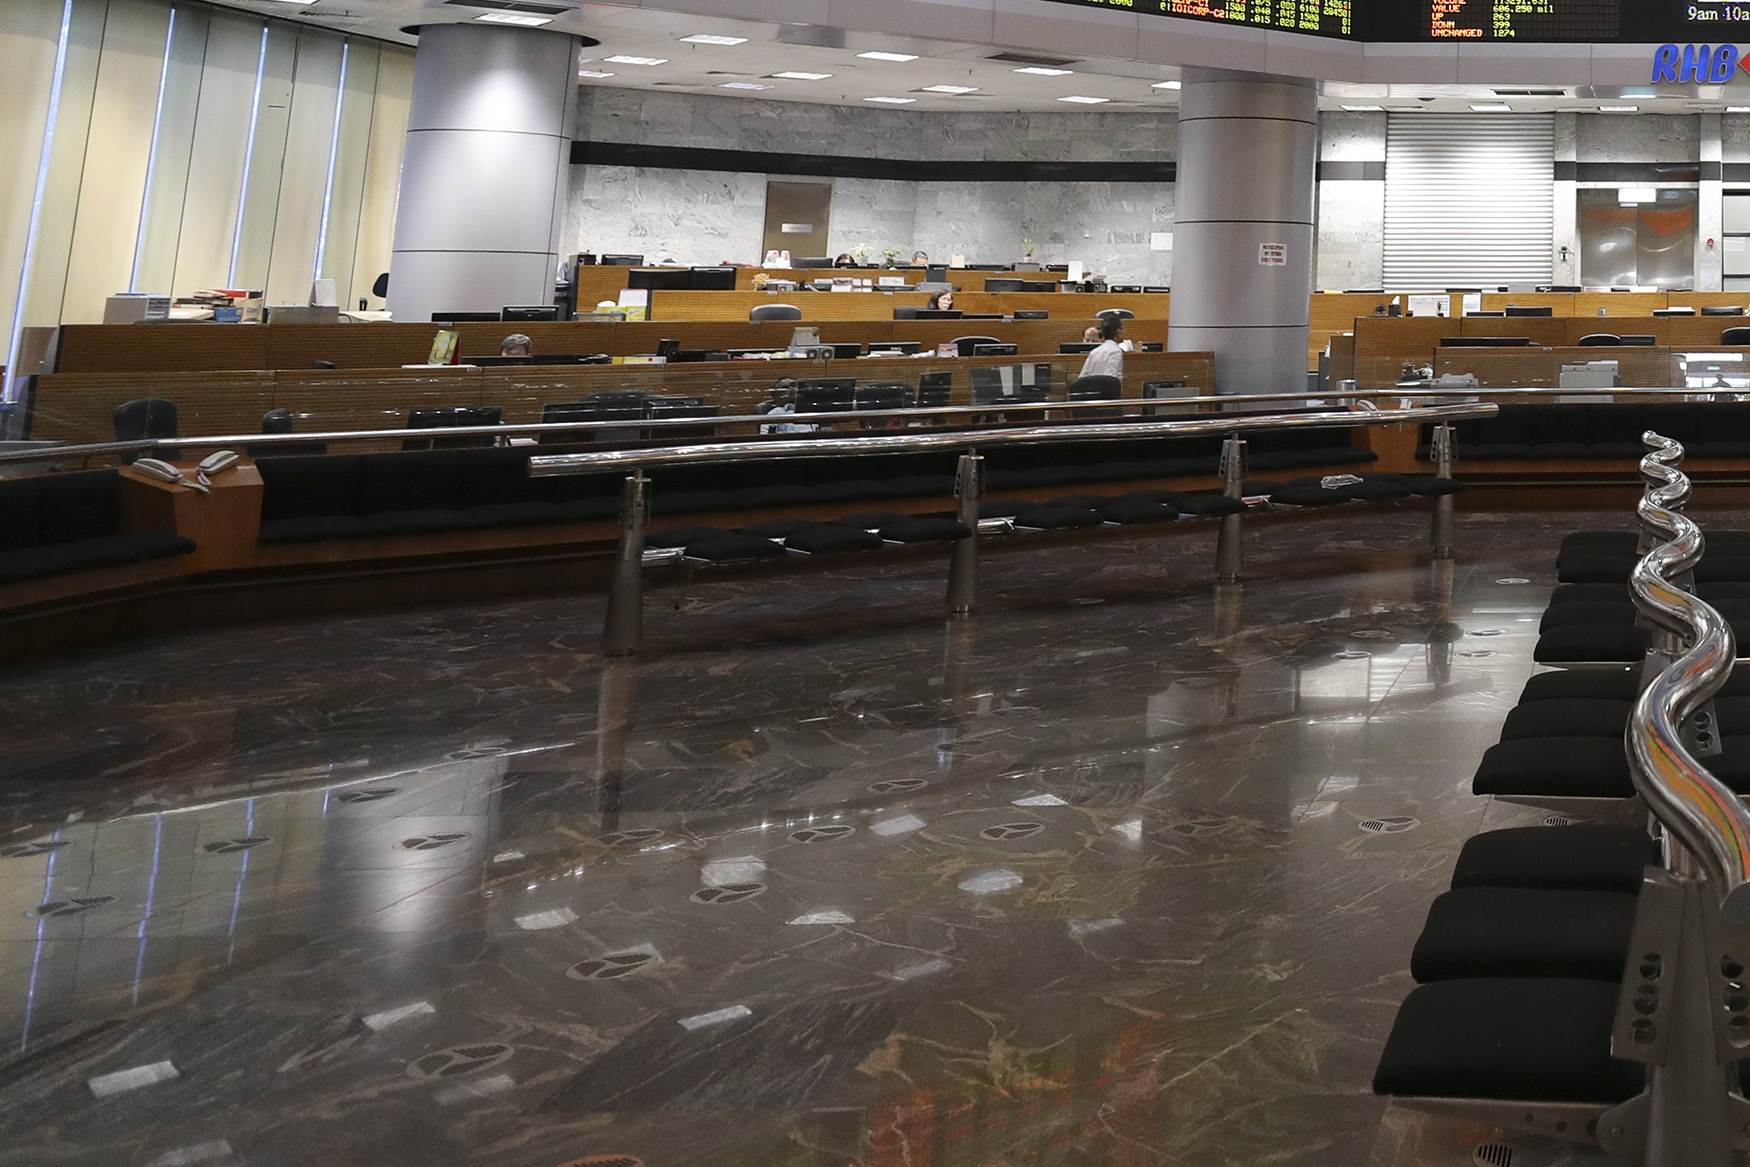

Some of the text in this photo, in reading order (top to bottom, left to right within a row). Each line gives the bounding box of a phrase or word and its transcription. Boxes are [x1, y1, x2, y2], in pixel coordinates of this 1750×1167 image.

[1432, 4, 1460, 12] VALUE
[1537, 5, 1554, 13] mil
[1493, 13, 1510, 21] 263
[1688, 8, 1718, 21] 9am
[1431, 21, 1510, 29] DOWN 399
[1431, 29, 1516, 37] UNCHANGED 1274
[1650, 44, 1738, 84] RHB
